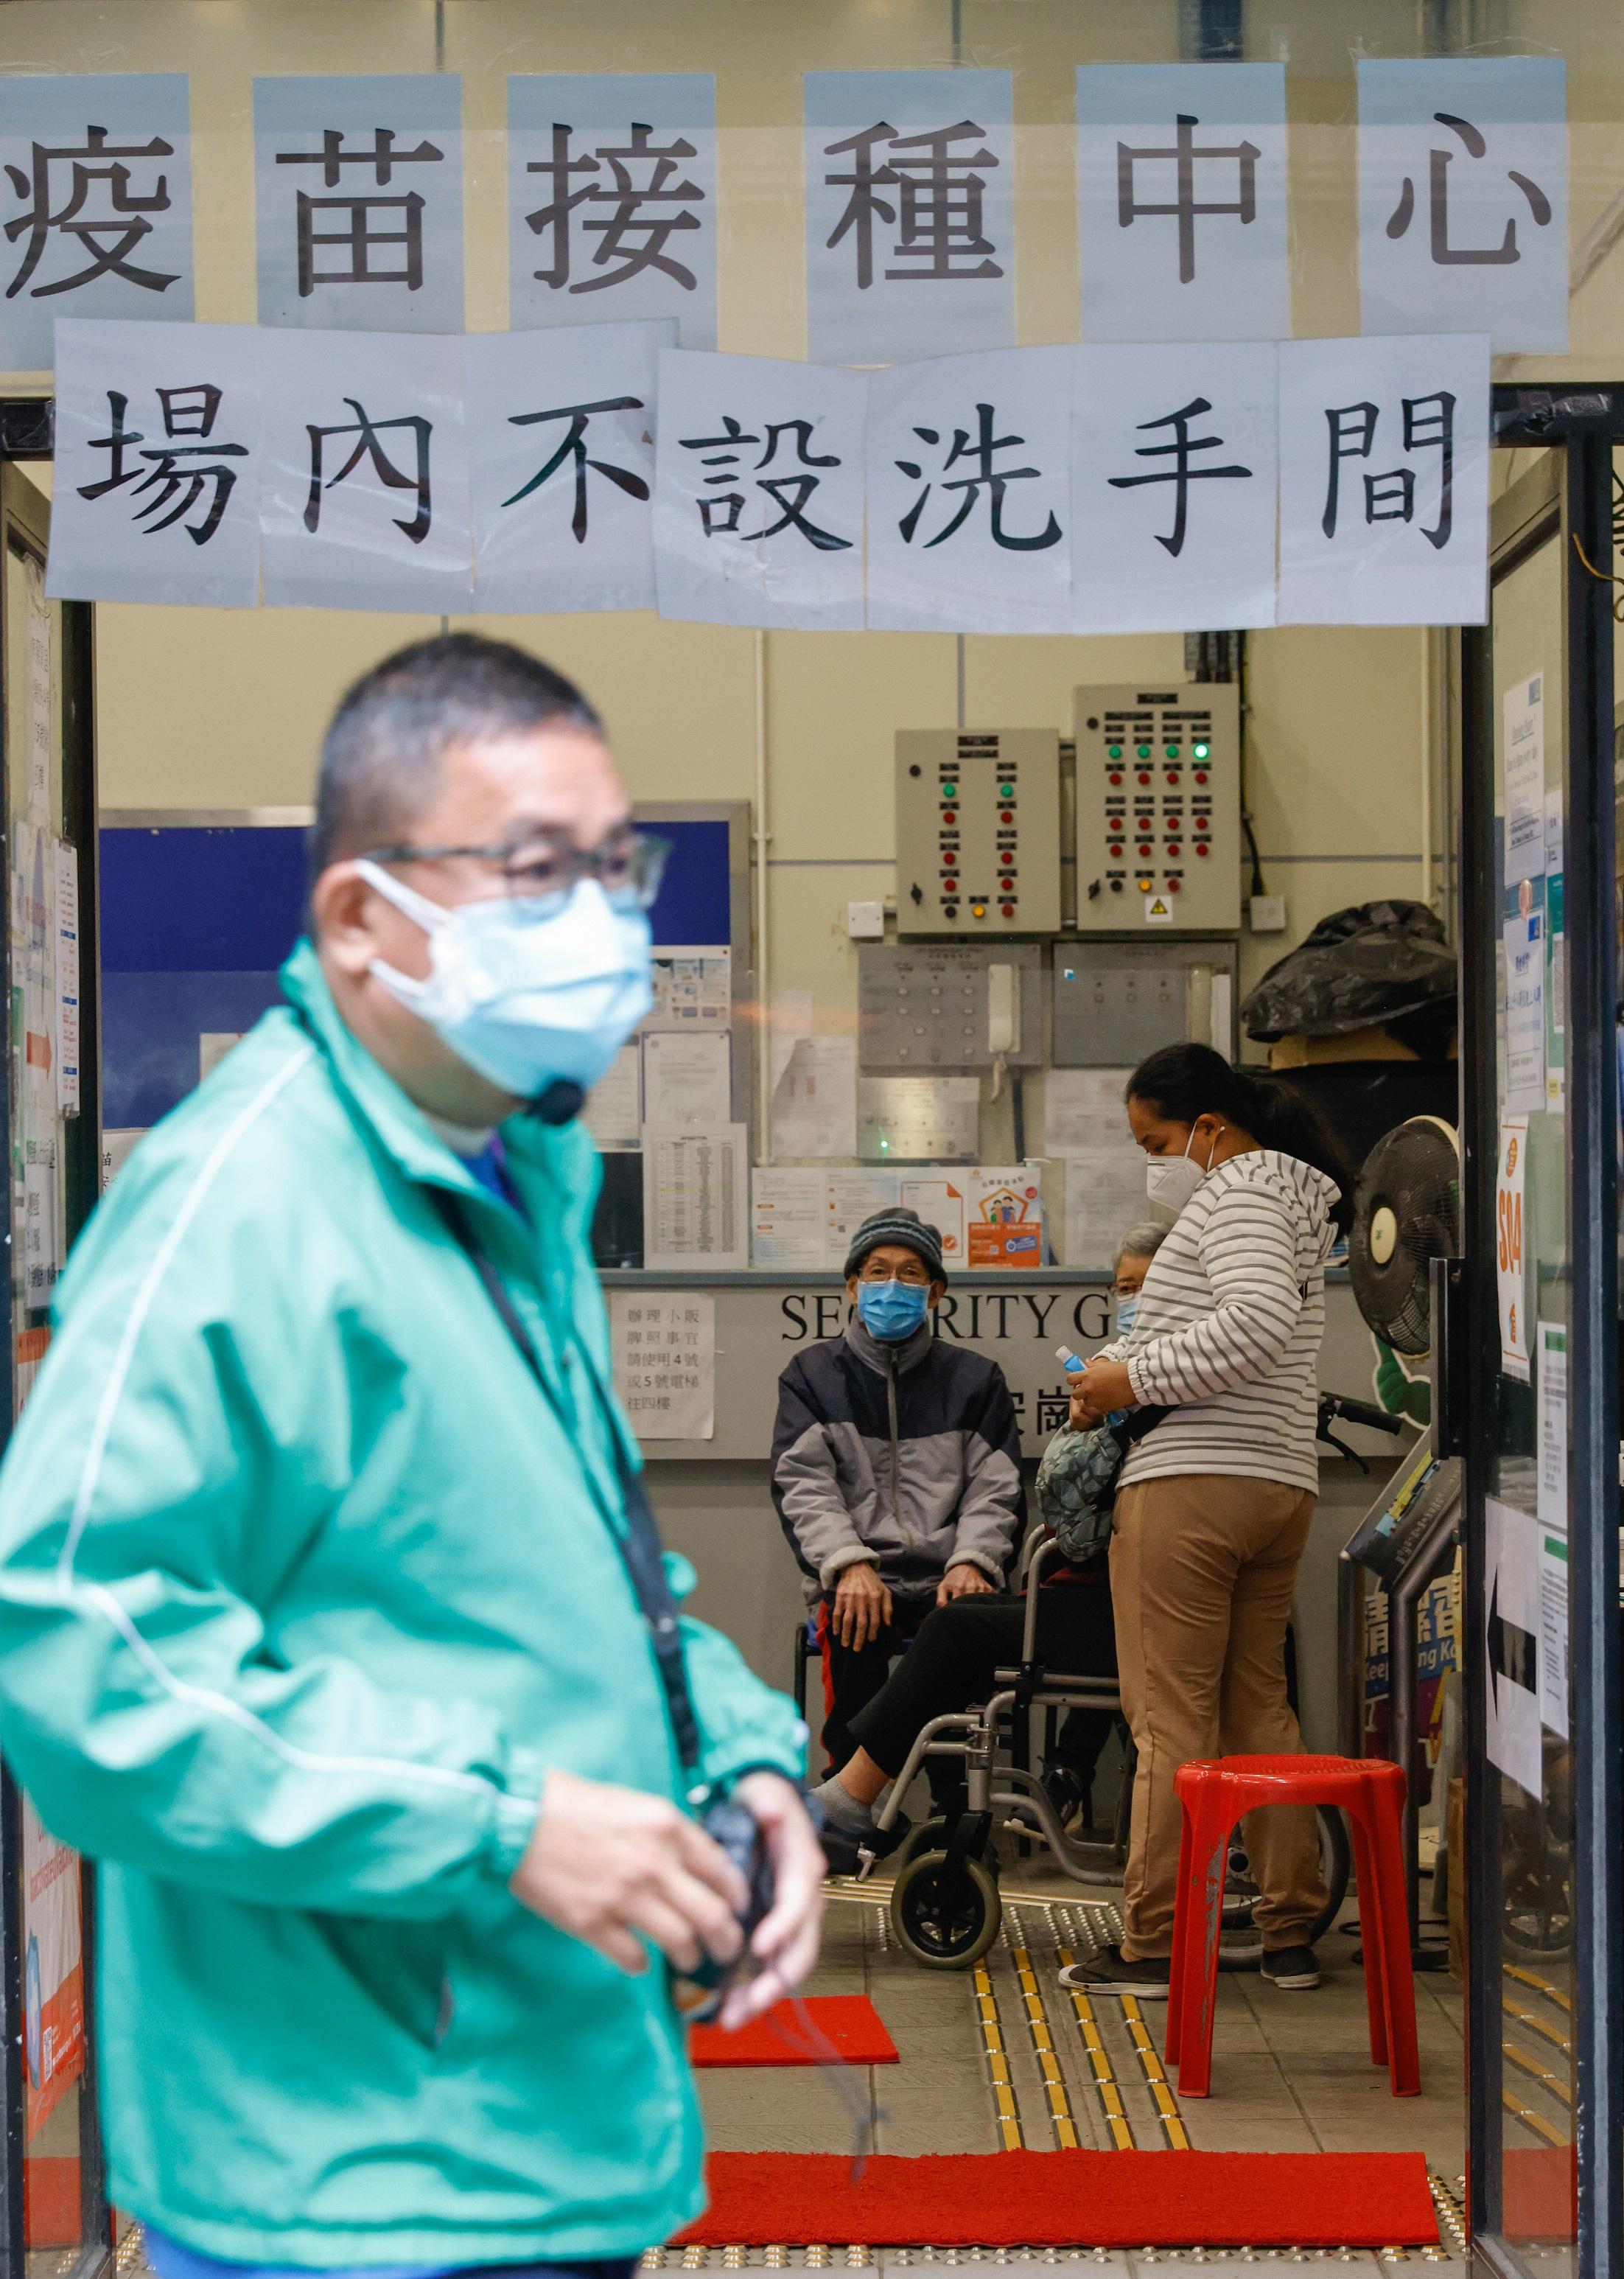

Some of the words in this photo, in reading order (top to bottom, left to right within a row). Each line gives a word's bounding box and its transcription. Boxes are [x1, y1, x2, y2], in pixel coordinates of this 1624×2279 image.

[3, 113, 1553, 299] 疫苗接種中心
[77, 383, 1454, 558] 場內不設洗手間
[781, 1294, 1061, 1341] SERITY
